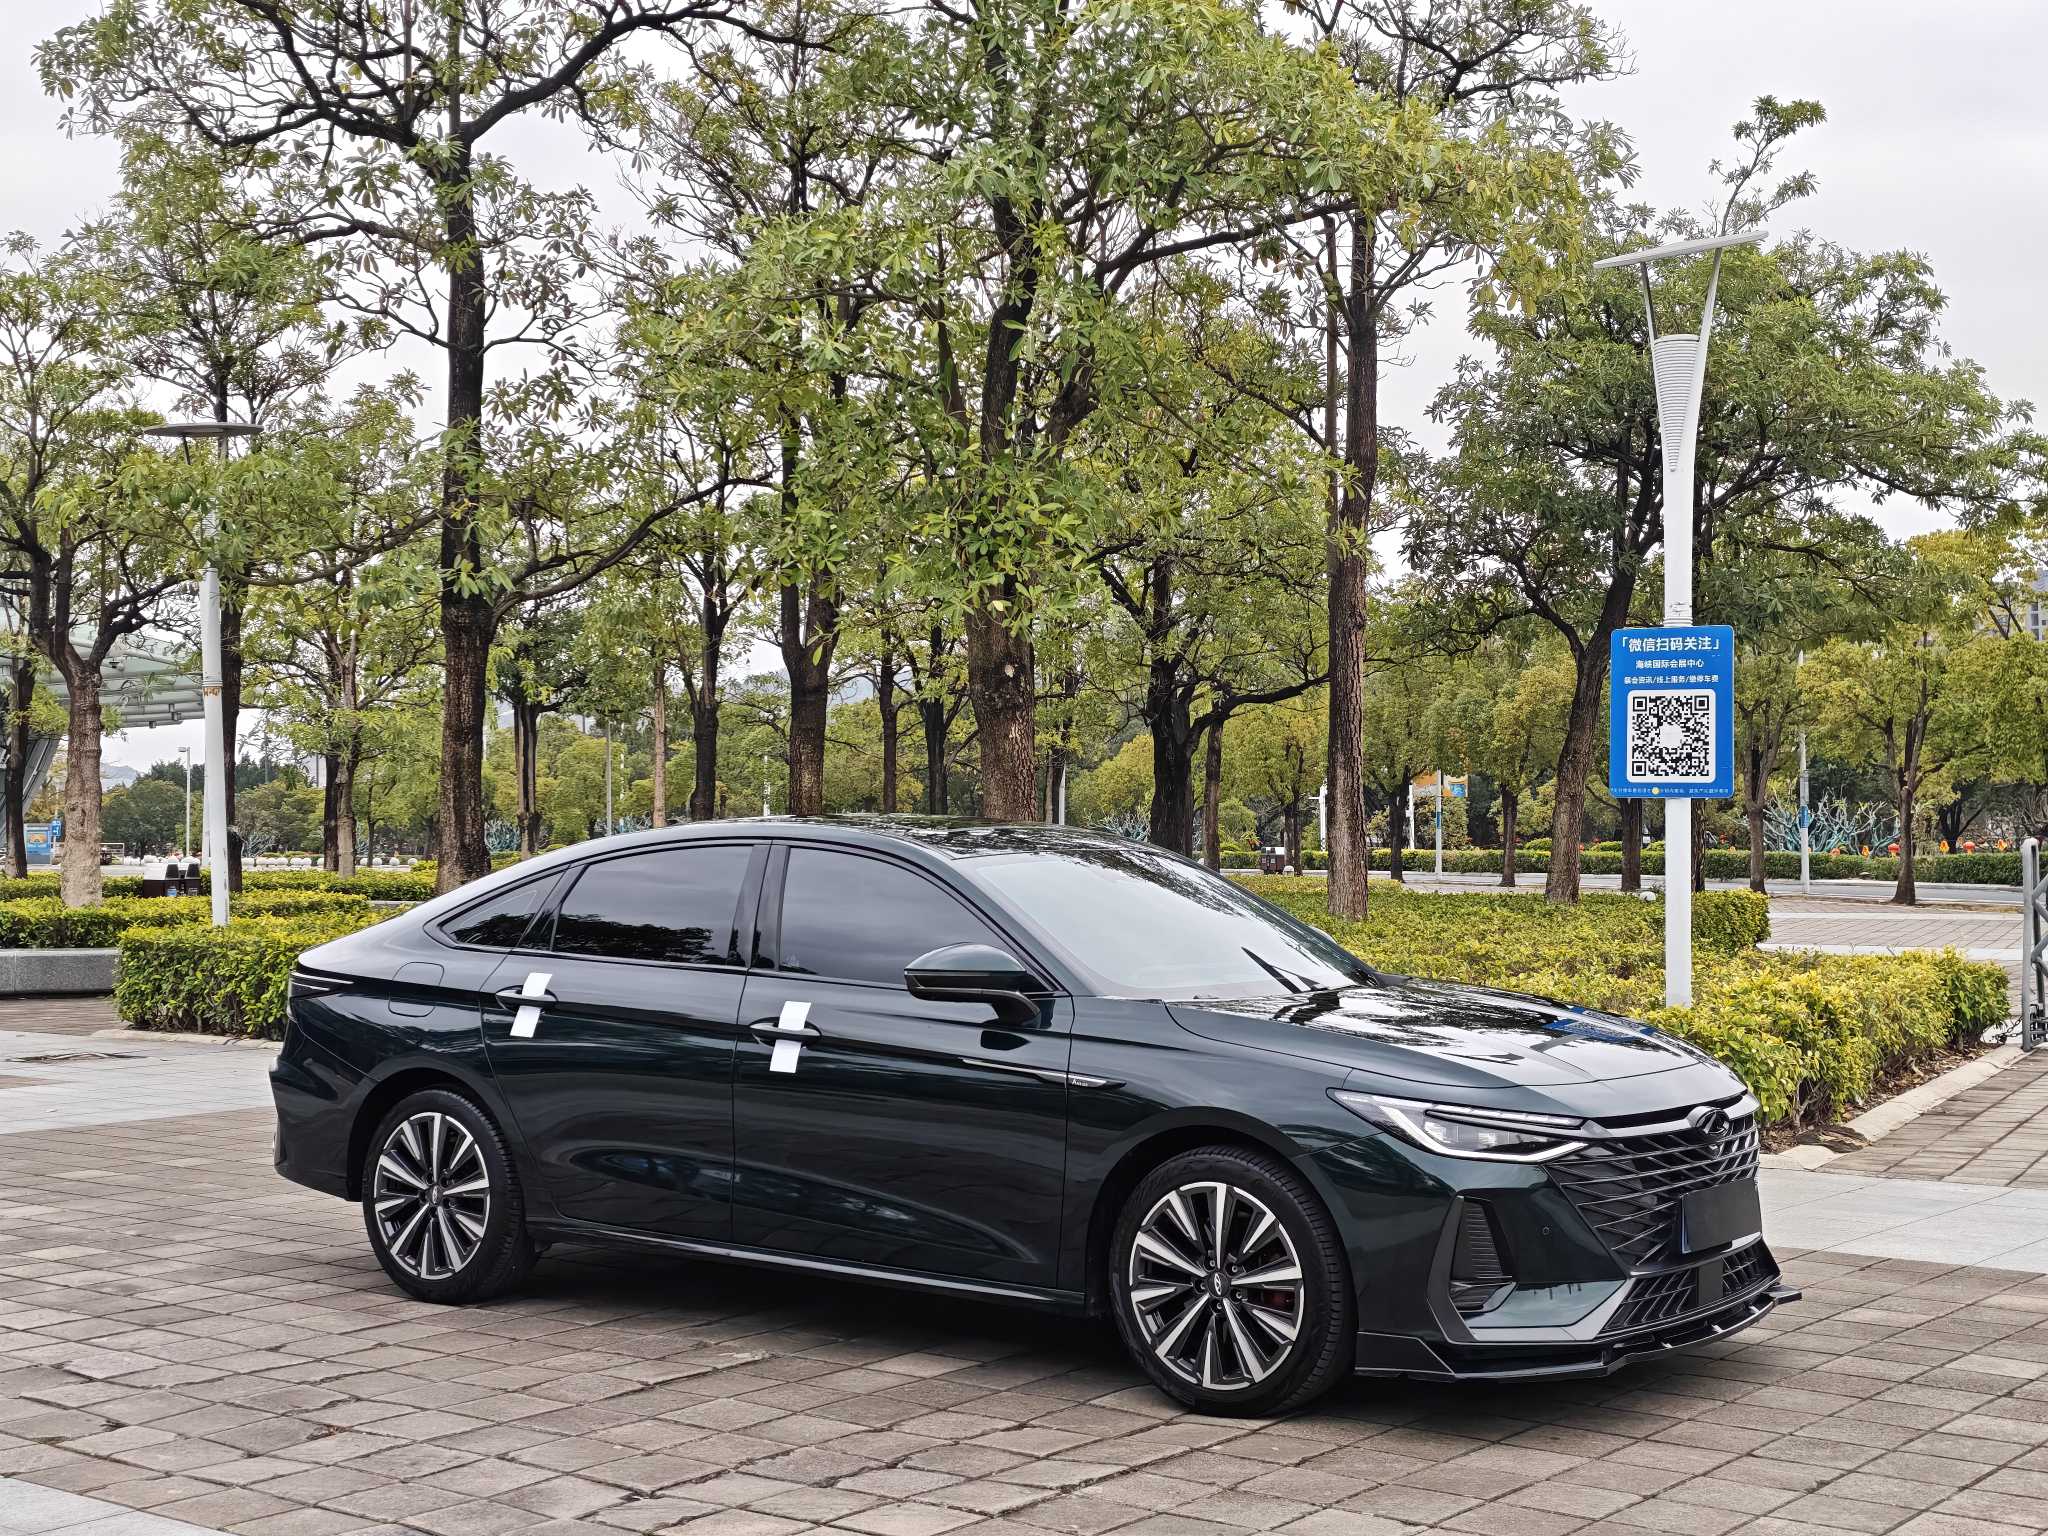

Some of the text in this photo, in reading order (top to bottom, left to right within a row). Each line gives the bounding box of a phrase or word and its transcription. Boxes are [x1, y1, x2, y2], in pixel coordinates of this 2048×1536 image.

[1622, 636, 1719, 652] 「微信扫码关注」
[1635, 659, 1704, 669] 海峡国际会展中心
